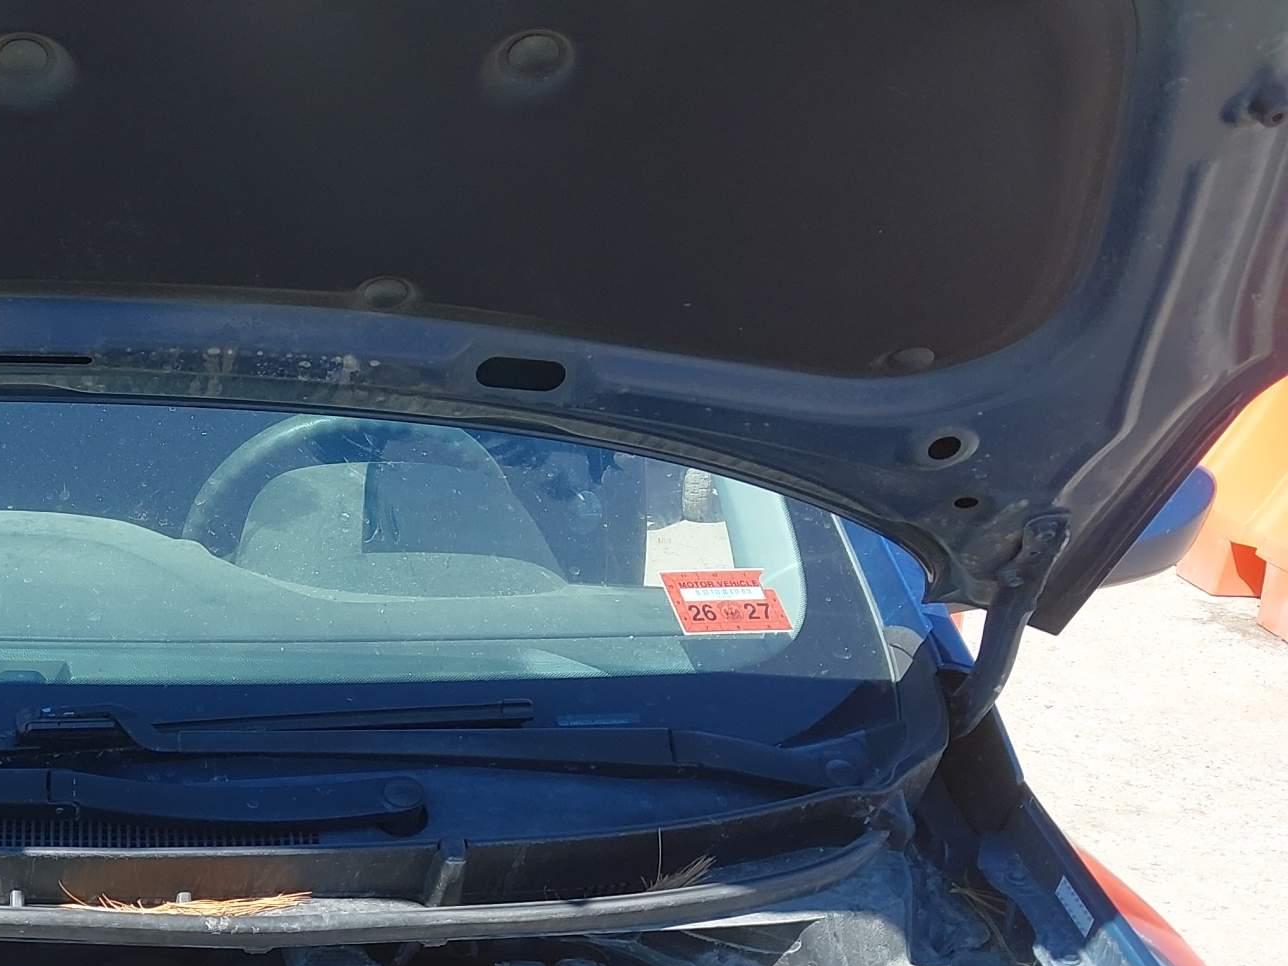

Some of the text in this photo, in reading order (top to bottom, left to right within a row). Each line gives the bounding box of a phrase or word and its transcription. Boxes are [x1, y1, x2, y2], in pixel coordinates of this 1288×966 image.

[678, 580, 760, 589] MOTOR VEHICLE
[688, 603, 770, 621] 26 27
